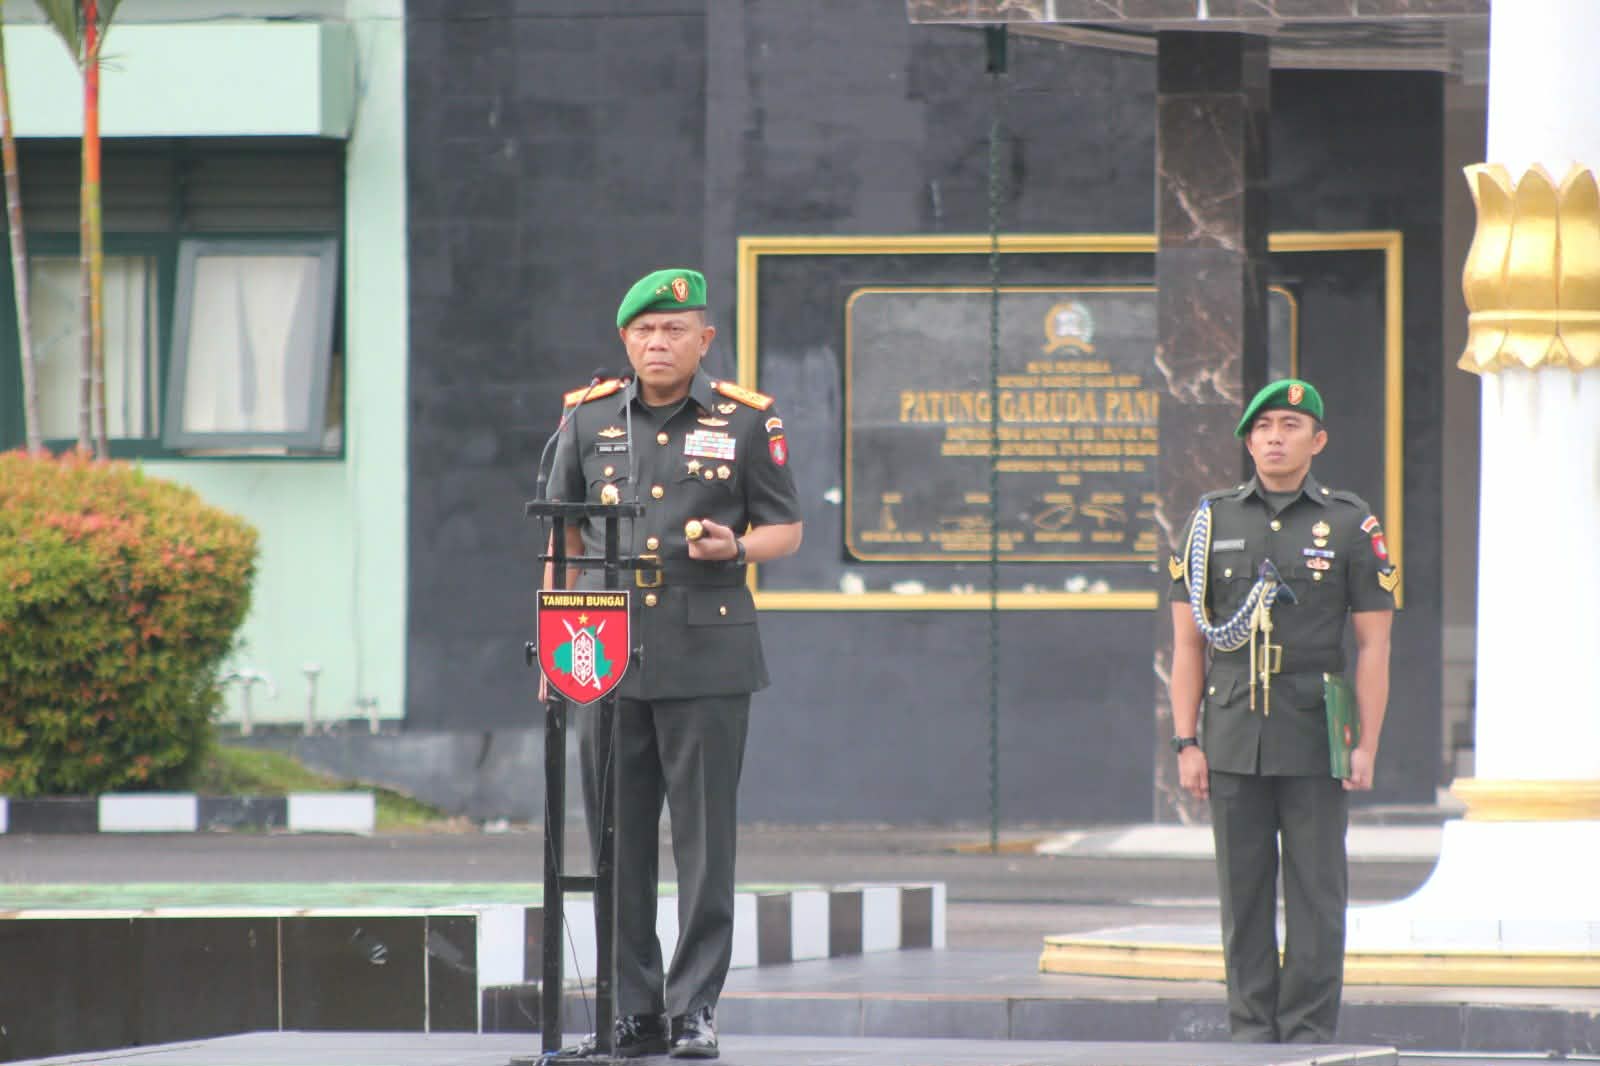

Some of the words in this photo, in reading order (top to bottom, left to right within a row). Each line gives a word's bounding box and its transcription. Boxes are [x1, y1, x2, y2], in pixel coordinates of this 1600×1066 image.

[900, 390, 992, 423] PATUNG
[999, 390, 1097, 423] GARUDA
[542, 595, 584, 606] TAMBUN
[586, 595, 625, 606] BUNGAI
